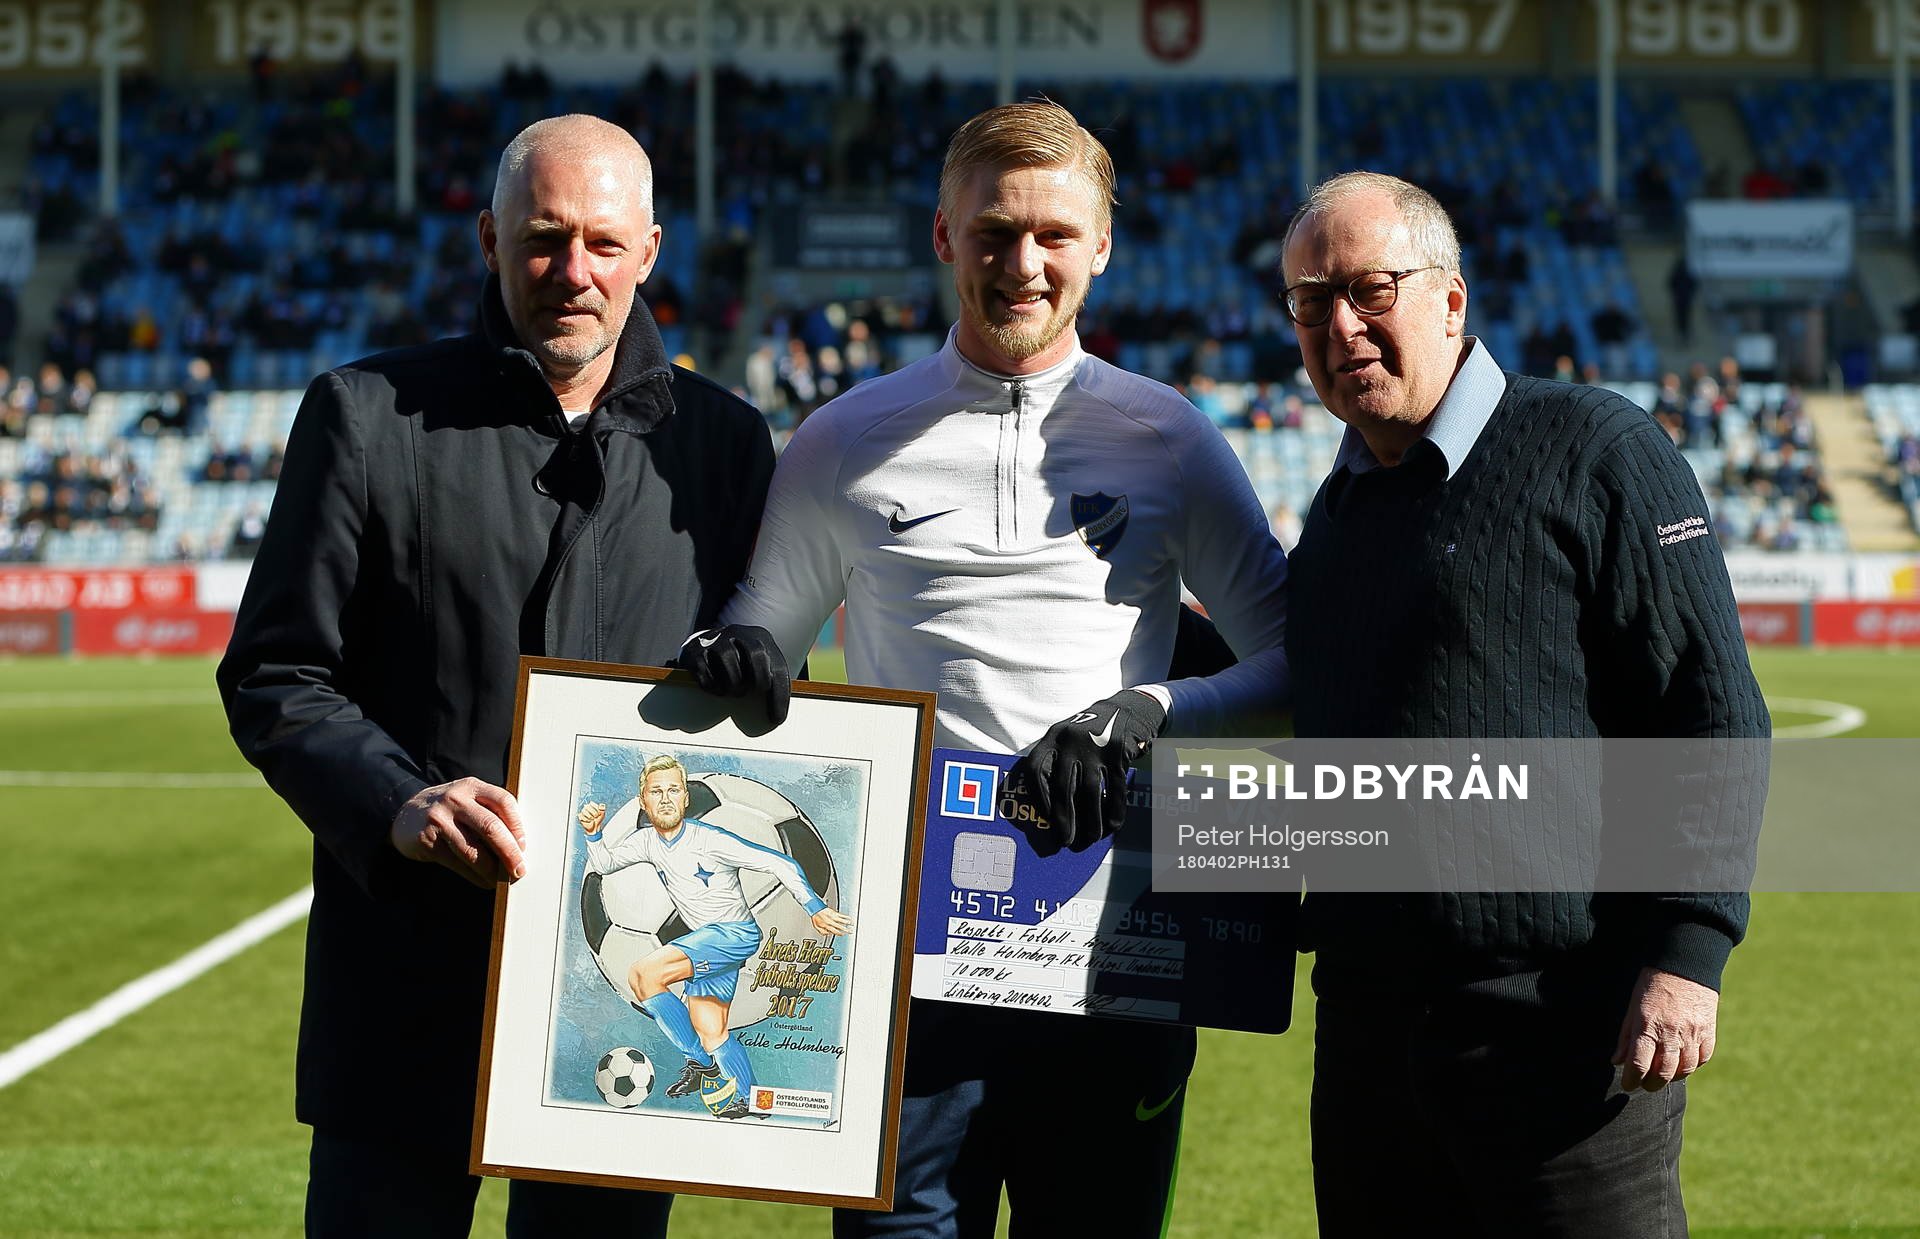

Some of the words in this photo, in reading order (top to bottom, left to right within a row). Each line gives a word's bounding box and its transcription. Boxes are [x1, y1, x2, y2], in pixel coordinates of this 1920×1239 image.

[1321, 0, 1518, 54] 1957
[1594, 0, 1799, 56] 960
[950, 890, 1016, 918] 4572
[1019, 928, 1071, 945] Fotboll
[950, 940, 986, 956] Kalle
[766, 994, 814, 1020] 2017
[774, 1021, 813, 1032] Östergötland
[736, 1031, 770, 1049] Kalle
[774, 1035, 845, 1060] Holmberg
[704, 1080, 720, 1089] IFK
[775, 1101, 830, 1110] FOTBOLLFÖRBUND
[776, 1094, 826, 1104] ÖSTERGÖTLANDS
